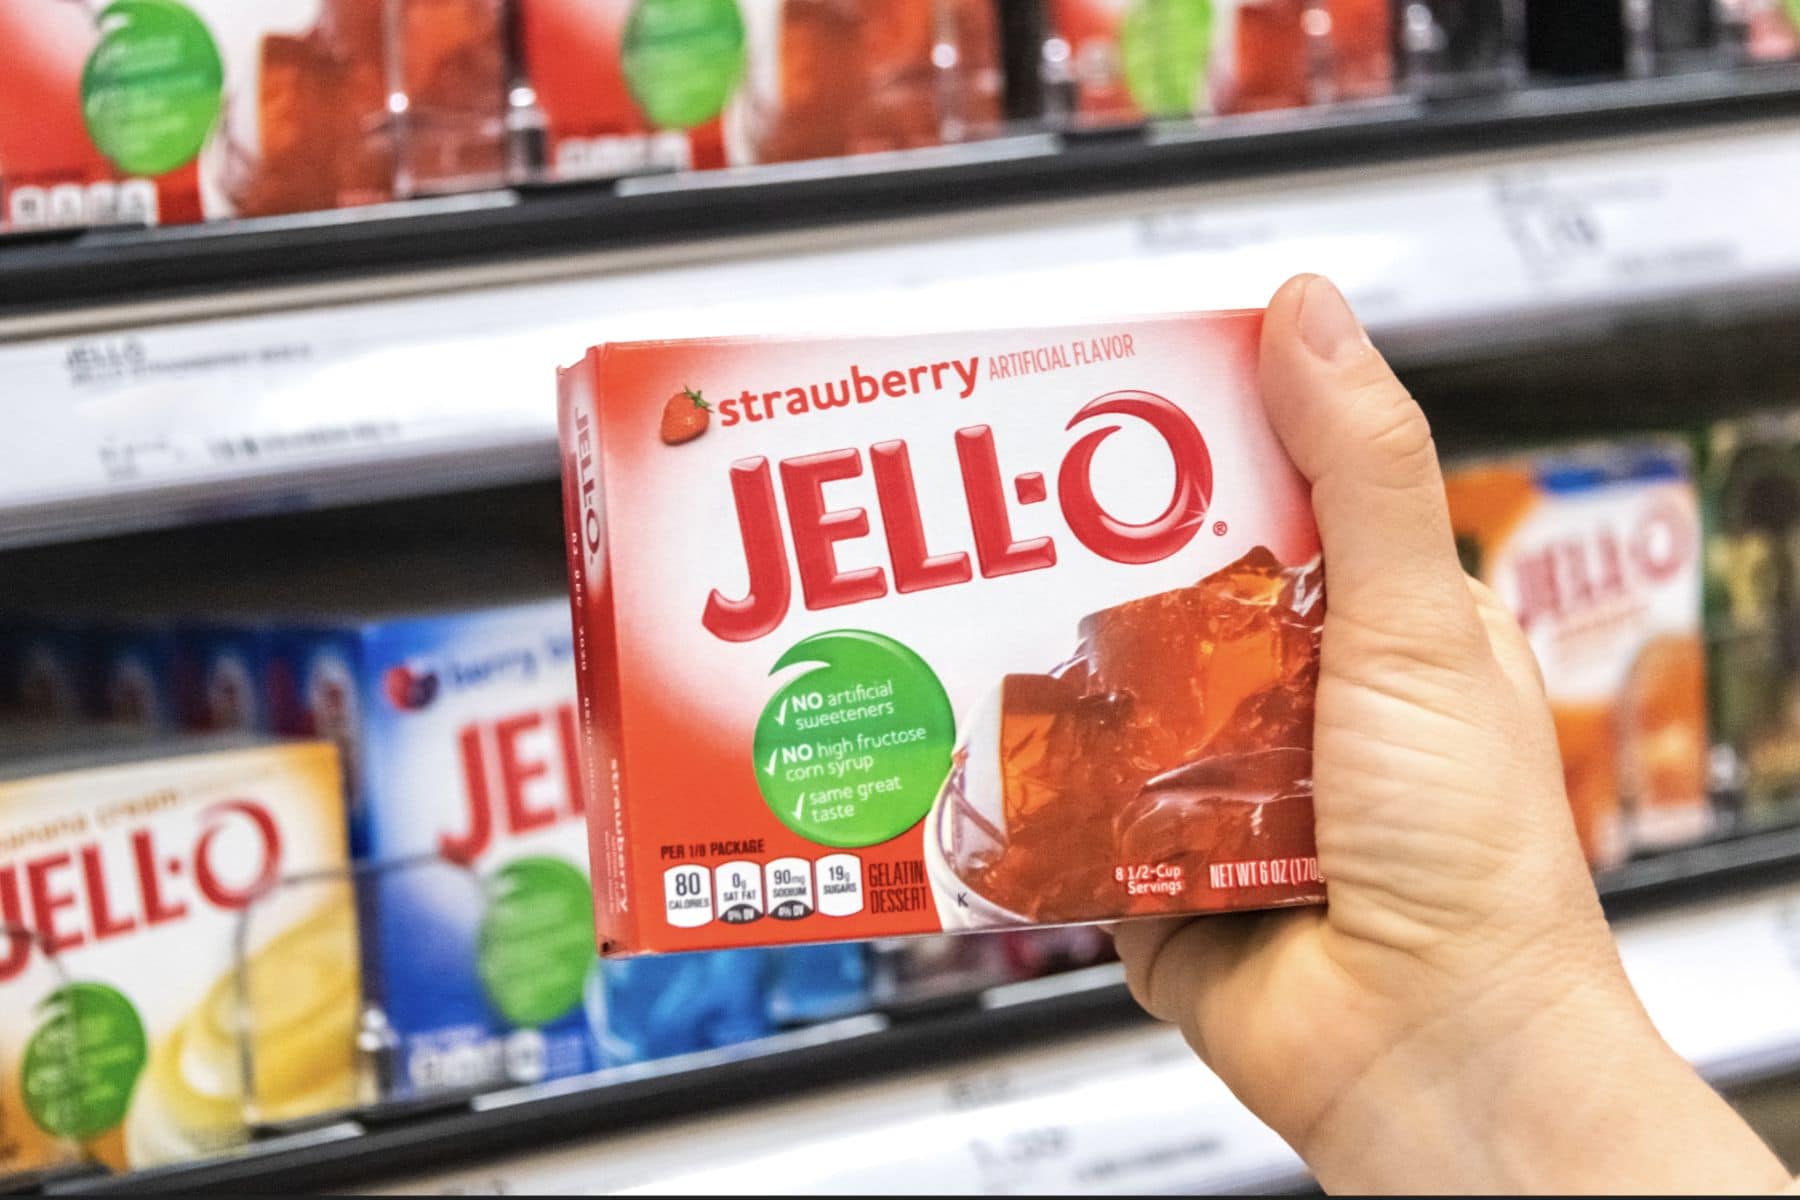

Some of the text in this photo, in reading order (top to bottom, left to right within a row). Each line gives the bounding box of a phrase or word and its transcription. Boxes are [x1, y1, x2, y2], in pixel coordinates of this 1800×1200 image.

[718, 334, 1137, 427] strawberry ARTIFICIAL FLAVOR
[701, 389, 1214, 643] JELL-O
[792, 680, 893, 713] NO artificial
[795, 701, 894, 731] sweeteners
[782, 727, 927, 764] NO high fructose
[786, 755, 874, 782] corn syrup
[809, 776, 903, 805] same great
[811, 803, 855, 823] taste
[660, 839, 764, 860] PER 1/8 PACKAGE
[675, 872, 701, 897] 80
[829, 865, 850, 881] 19g
[868, 861, 924, 887] GELATIN
[1115, 864, 1181, 881] 8 1/2-Cup
[1210, 863, 1234, 888] NET
[1235, 862, 1257, 887] WT
[1260, 861, 1268, 885] 6
[1270, 859, 1288, 884] OZ
[723, 888, 757, 902] SAT FAT
[773, 886, 807, 899] SODIUM
[823, 882, 857, 895] SUGARS
[870, 886, 927, 914] DESSERT
[957, 892, 968, 908] K
[1128, 880, 1183, 896] Servings
[668, 897, 710, 911] CALORIES
